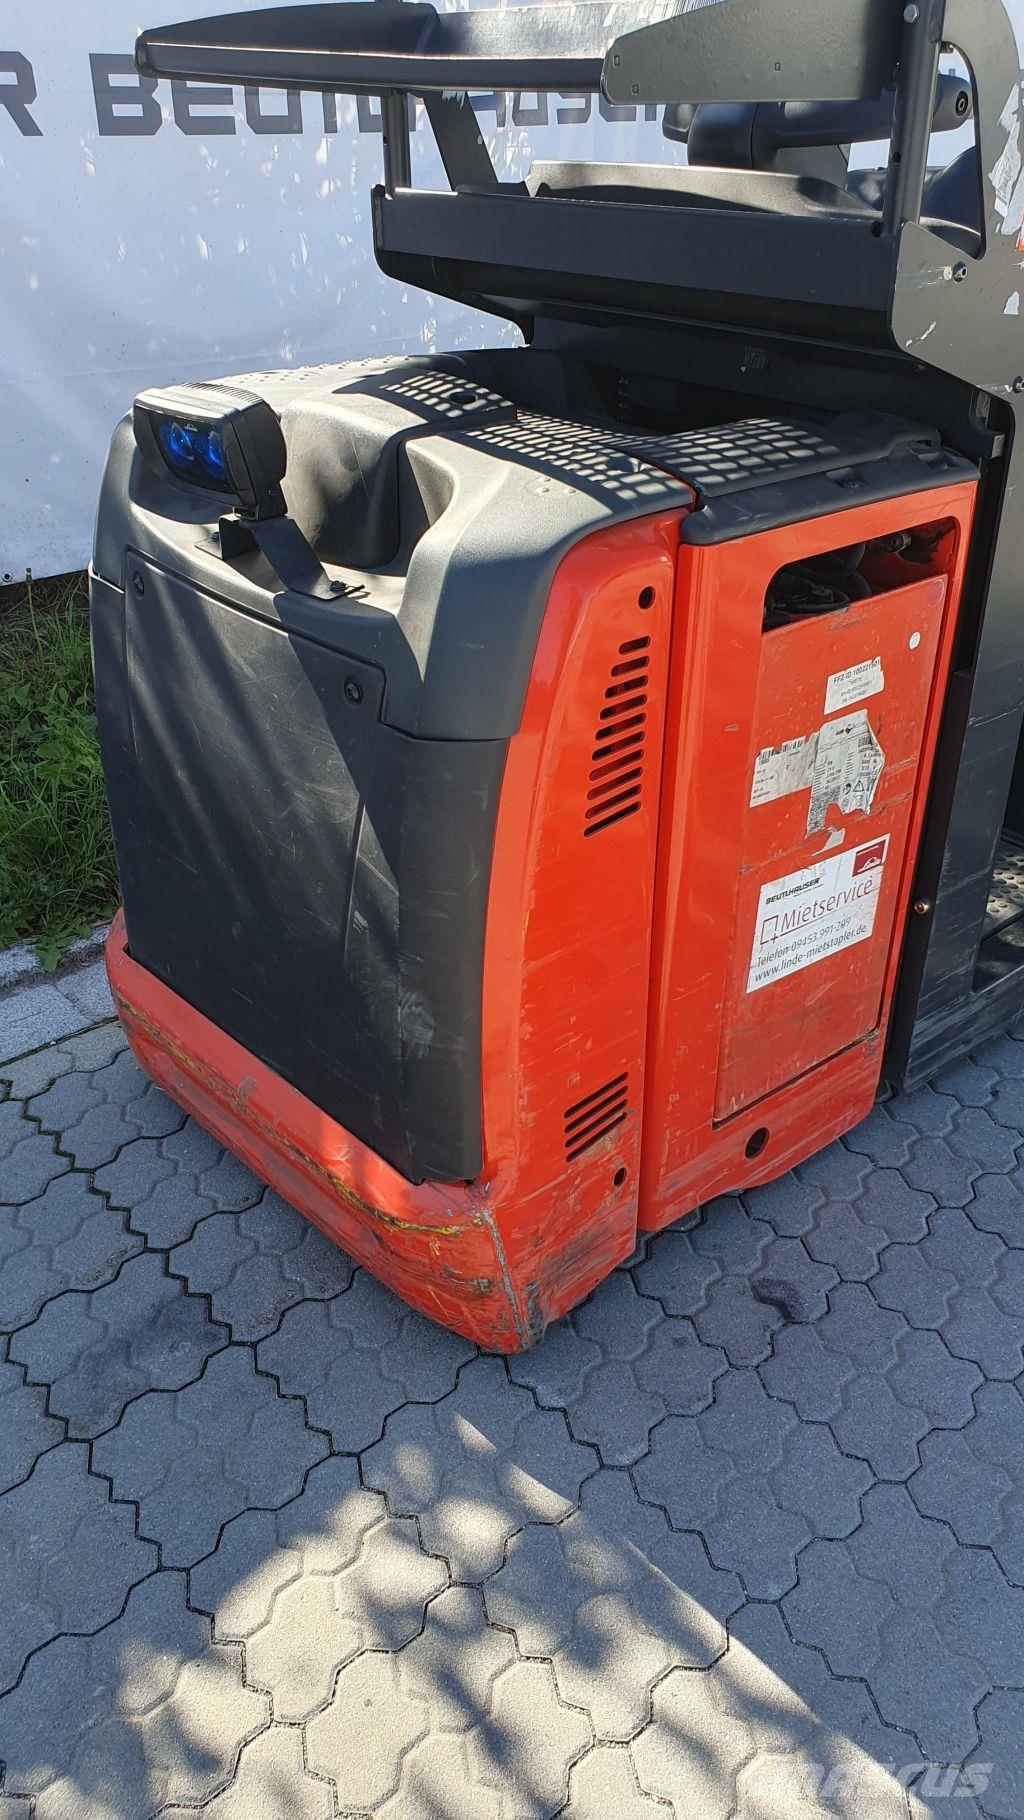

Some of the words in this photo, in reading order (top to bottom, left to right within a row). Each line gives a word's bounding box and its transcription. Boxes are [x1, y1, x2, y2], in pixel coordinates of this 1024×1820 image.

[765, 877, 820, 904] BEUTLHAUSER
[780, 878, 873, 932] Mietservice
[754, 924, 867, 982] www.linde-mietstapler.de
